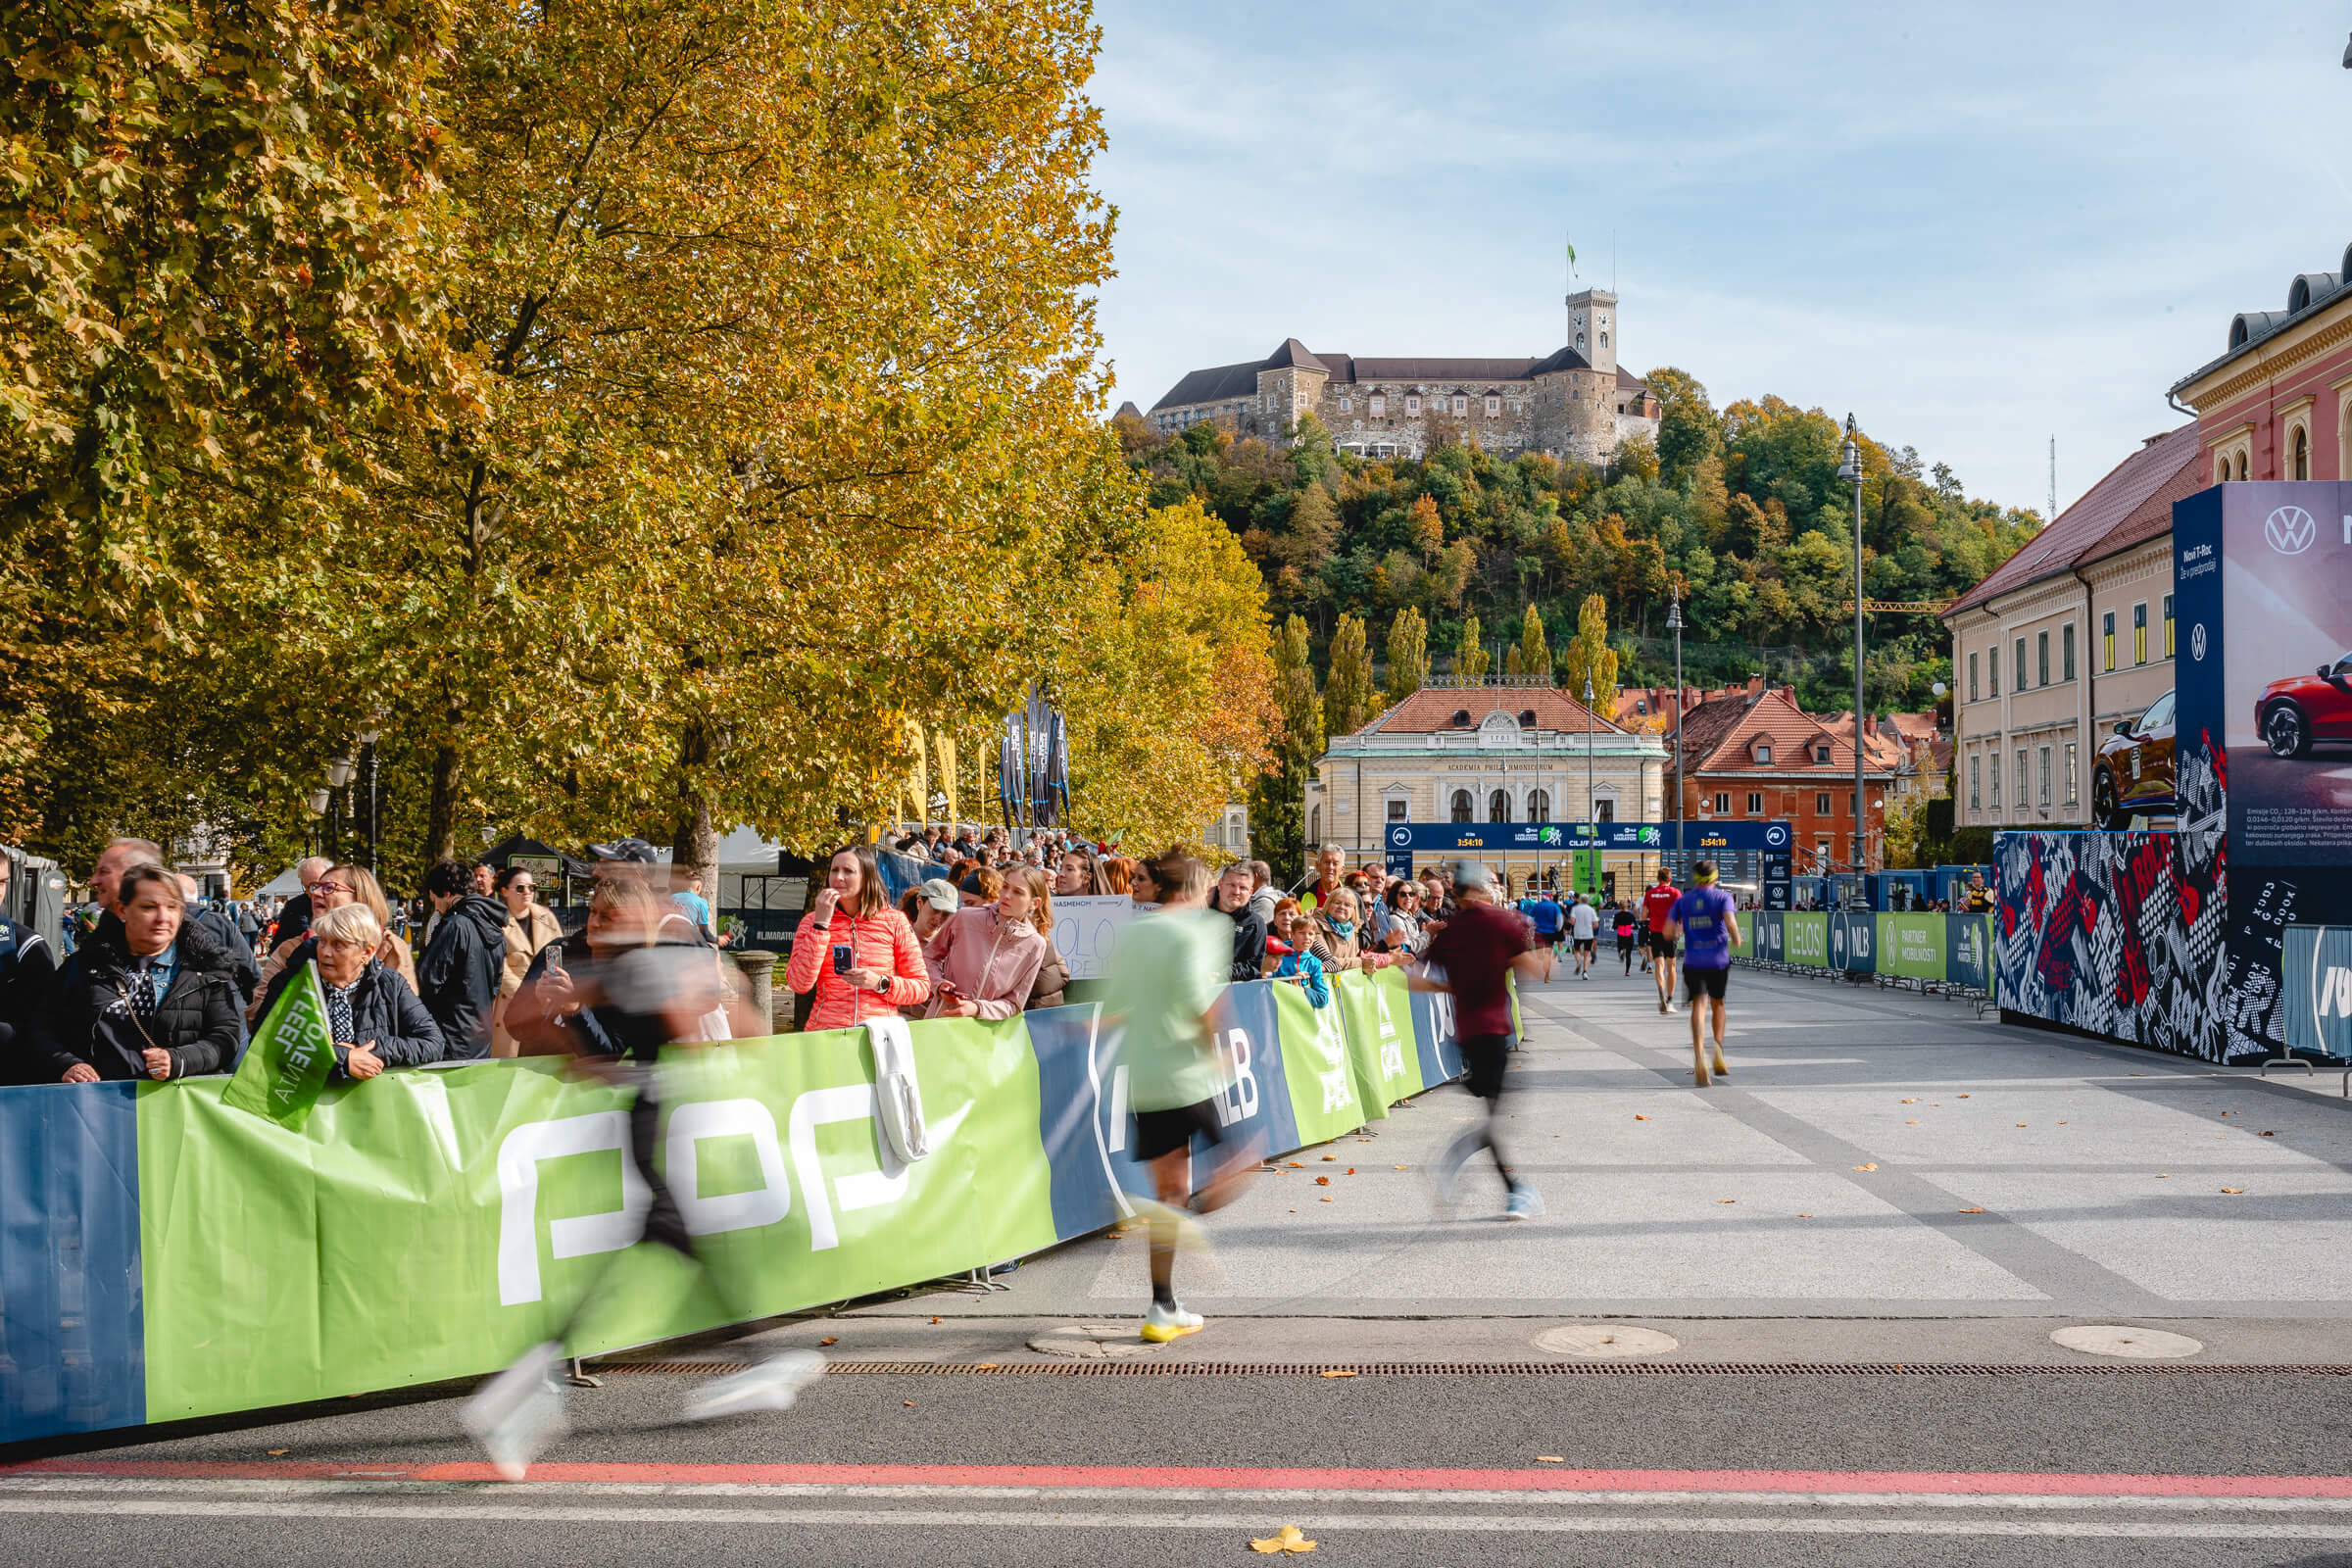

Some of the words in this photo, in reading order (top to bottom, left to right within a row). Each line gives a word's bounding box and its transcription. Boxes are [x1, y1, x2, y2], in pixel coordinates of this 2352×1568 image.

[2183, 548, 2196, 564] Novi
[2196, 544, 2212, 561] T-Roc
[1457, 838, 1483, 847] 3:54:10
[1700, 838, 1727, 847] 3:54:10
[1769, 923, 1781, 950] NLB
[1852, 926, 1870, 957] NLB
[1901, 929, 1927, 942] PARTNER
[1901, 947, 1936, 963] MOBILNOSTI
[498, 1082, 907, 1306] POP
